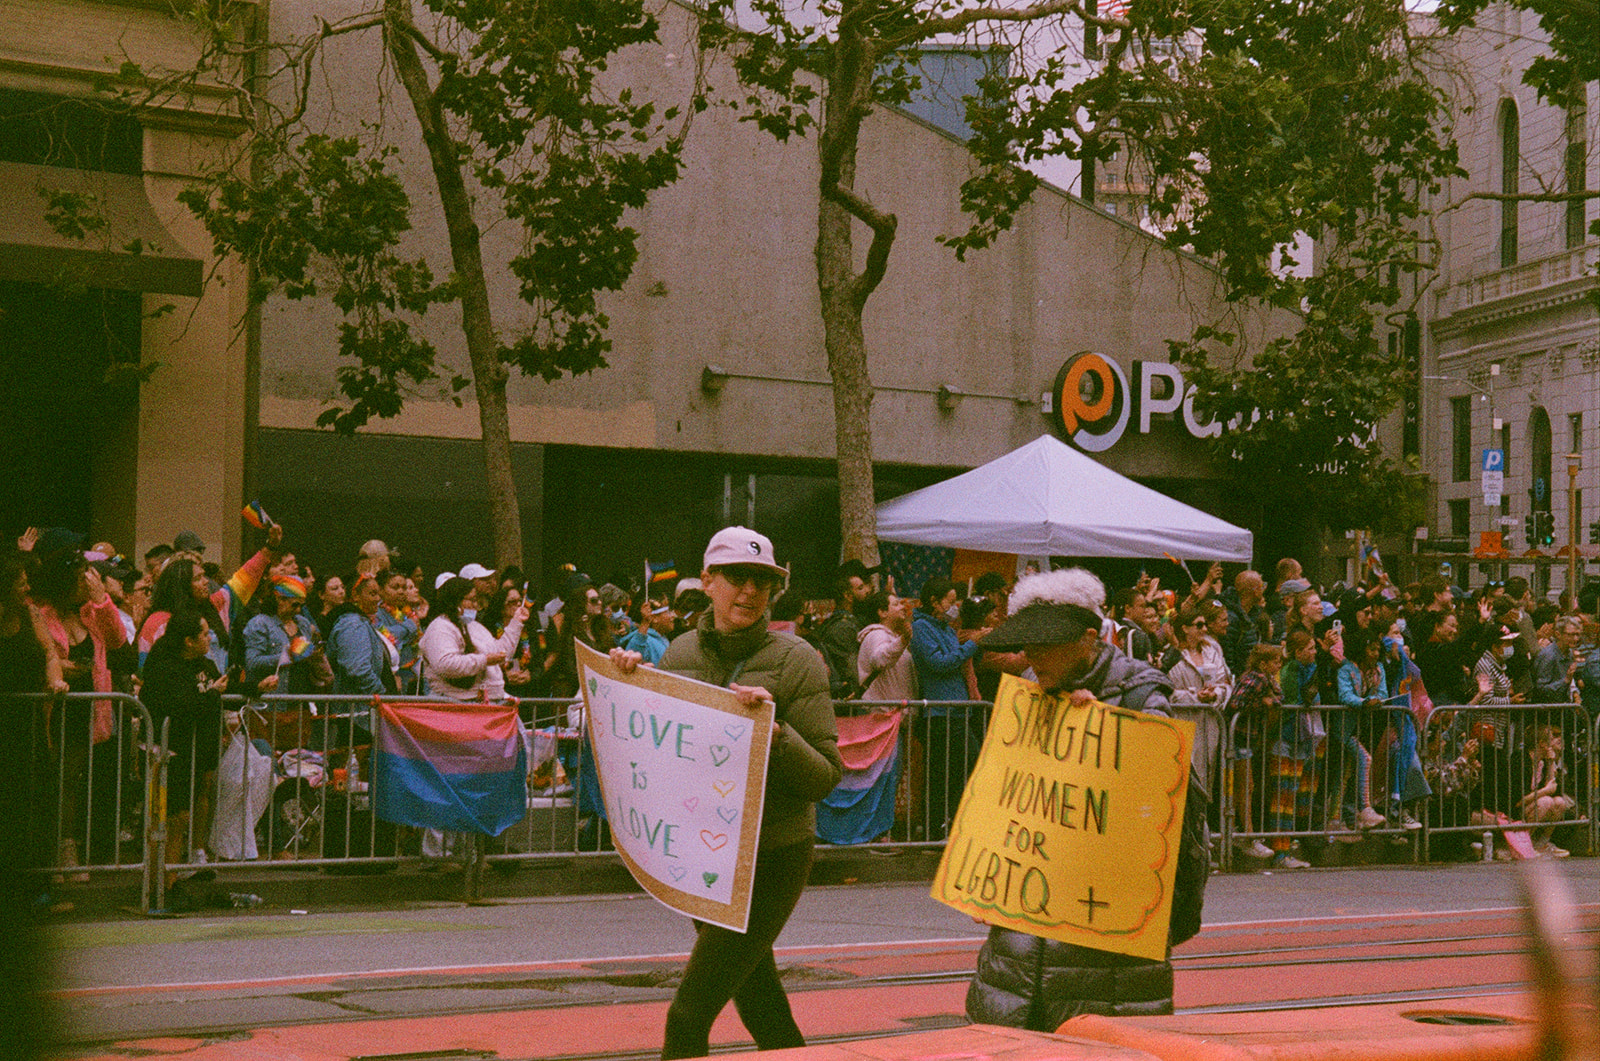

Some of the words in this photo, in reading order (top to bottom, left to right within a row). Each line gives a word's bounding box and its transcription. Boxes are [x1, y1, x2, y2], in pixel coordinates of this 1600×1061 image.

[611, 702, 696, 762] LOVE
[617, 796, 681, 859] LOVE
[999, 766, 1109, 835] WOMEN
[1003, 819, 1051, 861] FOR
[953, 838, 1051, 917] LGBTQ
